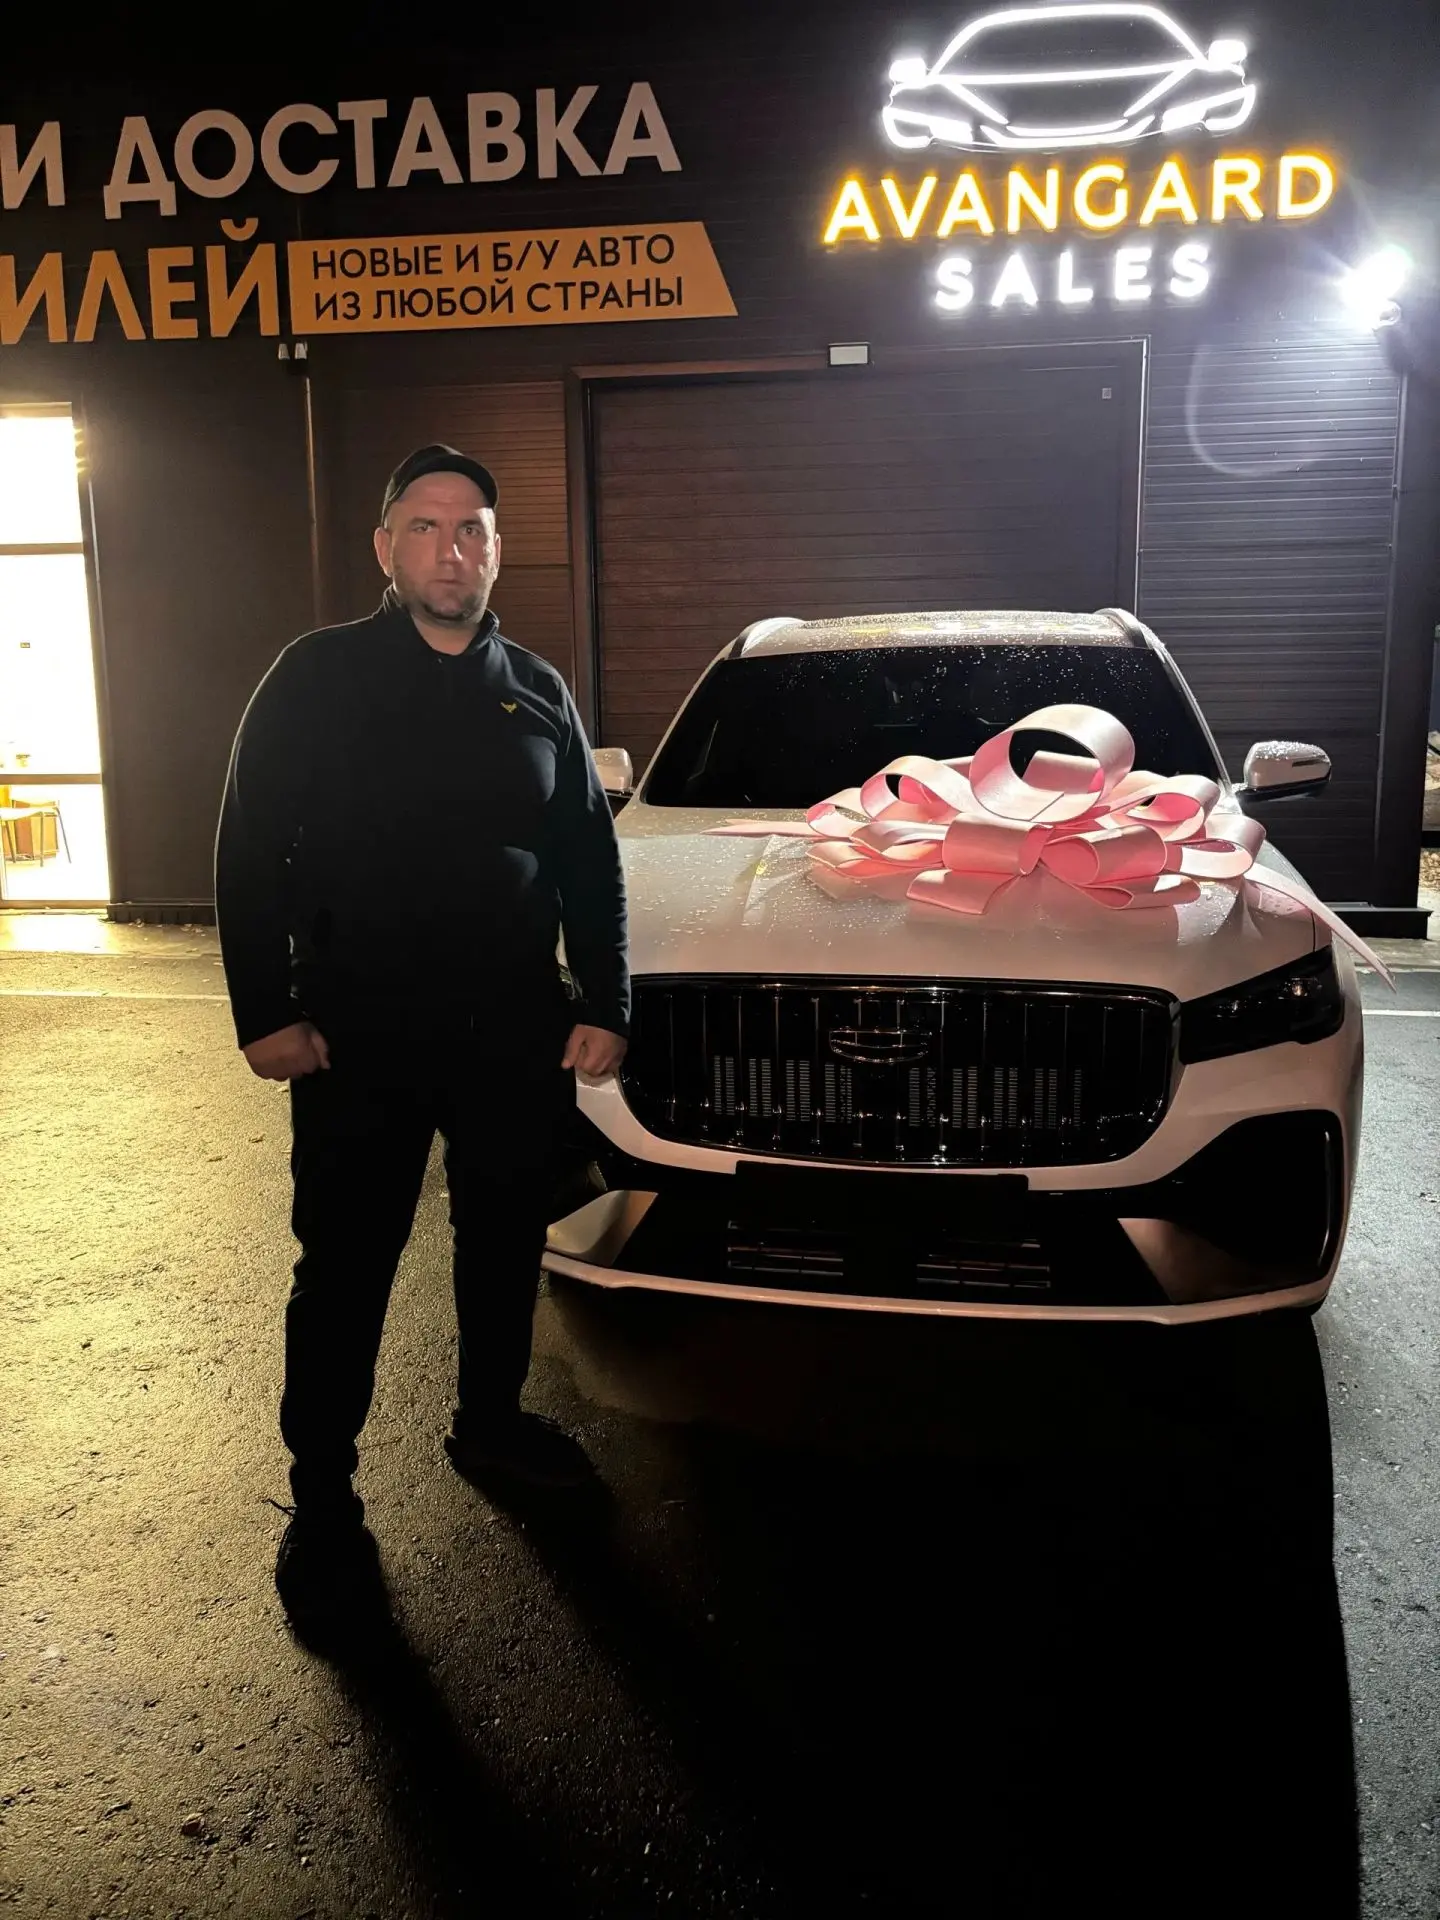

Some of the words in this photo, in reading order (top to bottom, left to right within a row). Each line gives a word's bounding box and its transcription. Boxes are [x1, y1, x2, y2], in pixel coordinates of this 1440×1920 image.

[0, 121, 65, 209] И
[104, 82, 683, 220] ДОСТАВКА
[822, 153, 1336, 245] AVANGARD
[312, 244, 443, 280] НОВЫЕ
[455, 243, 480, 274] И
[493, 240, 560, 272] Б/У
[573, 234, 676, 270] АВТО
[934, 243, 1211, 310] SALES
[313, 291, 362, 321] ИЗ
[373, 278, 515, 320] ЛЮБОЙ
[526, 276, 684, 313] СТРАНЫ
